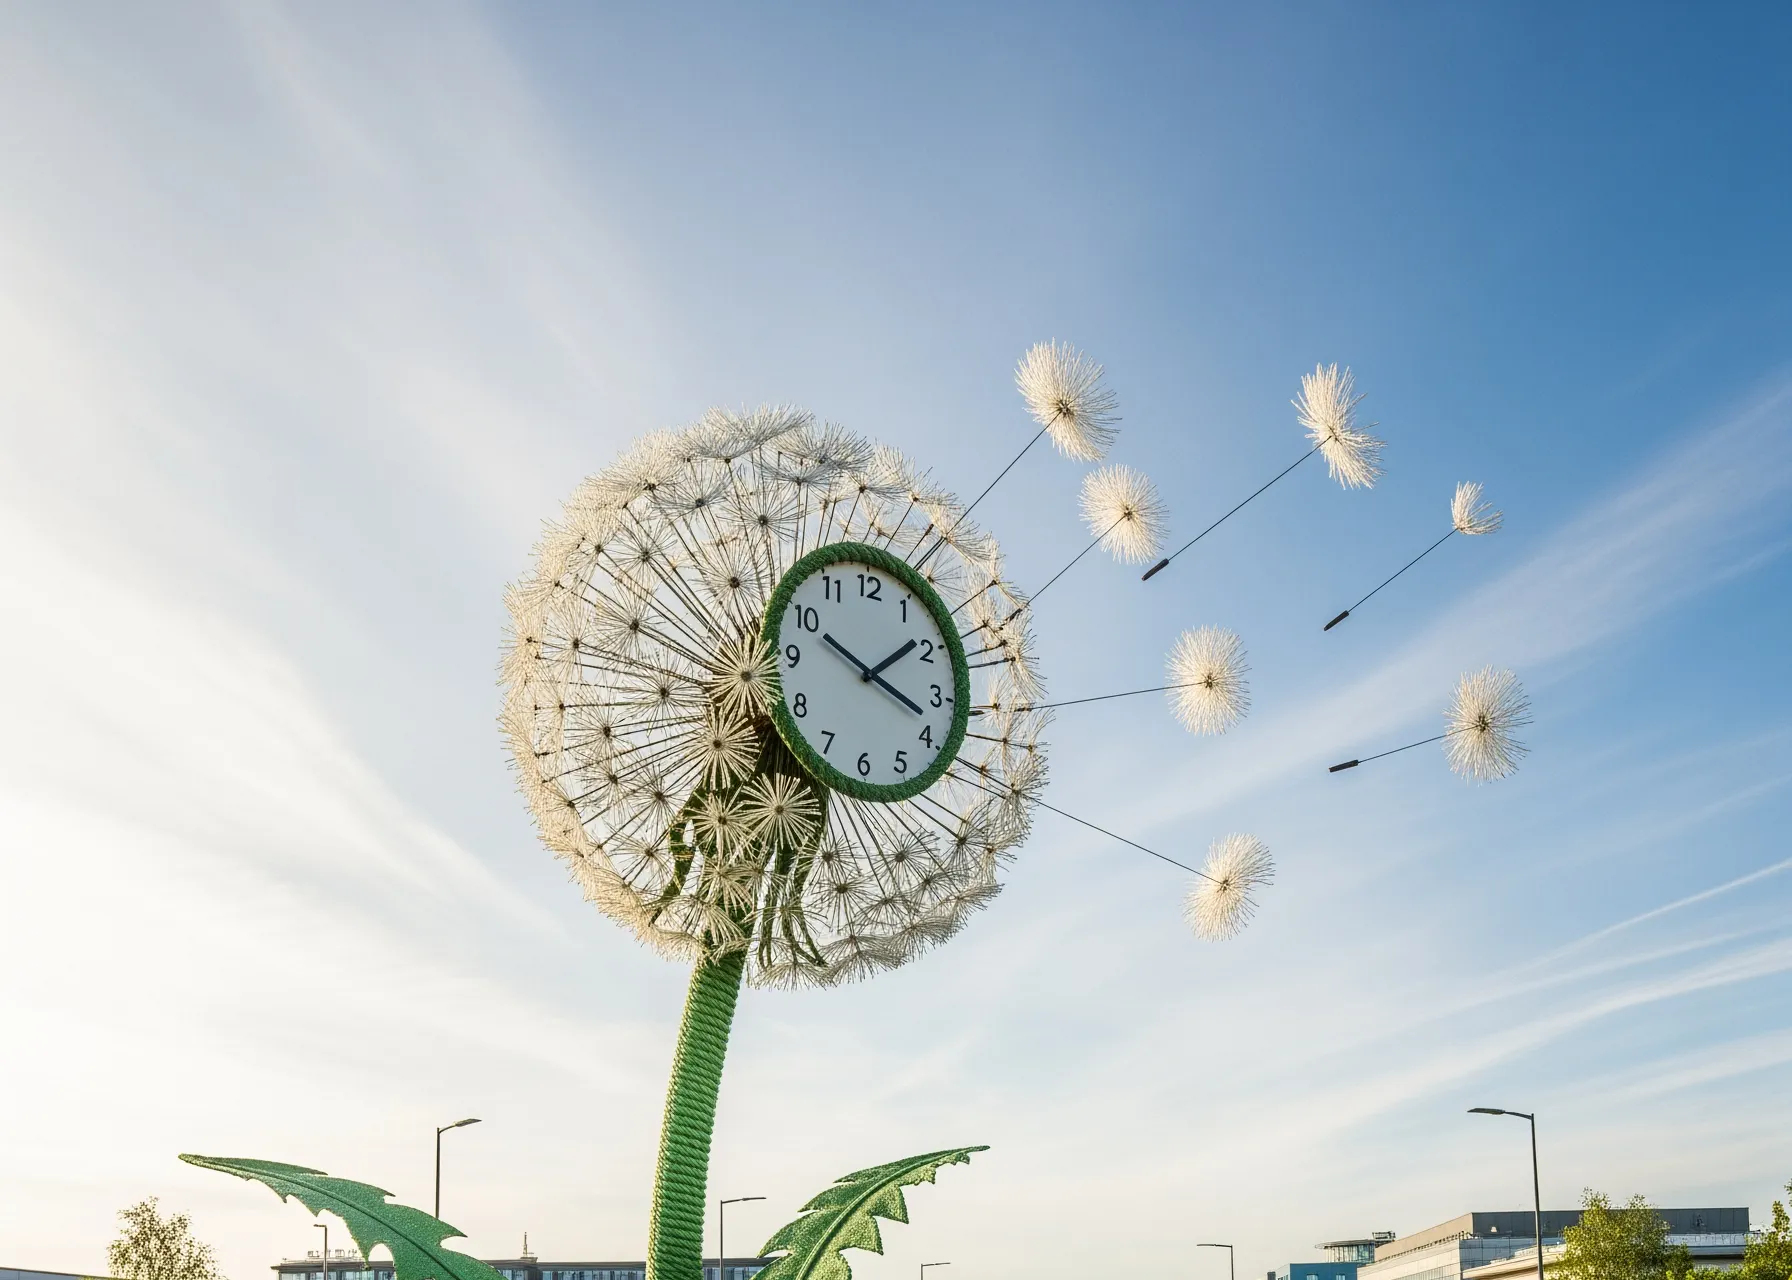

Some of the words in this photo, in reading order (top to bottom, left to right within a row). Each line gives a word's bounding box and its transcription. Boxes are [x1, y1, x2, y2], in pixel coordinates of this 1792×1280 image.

[823, 576, 841, 603] 11
[857, 574, 883, 602] 12
[795, 605, 819, 632] 10
[899, 599, 907, 623] 1
[786, 645, 800, 669] 9
[919, 639, 934, 664] 2
[793, 693, 808, 718] 8
[930, 684, 942, 708] 3
[821, 730, 836, 754] 7
[919, 725, 933, 748] 4
[857, 753, 870, 776] 6
[893, 750, 907, 773] 5
